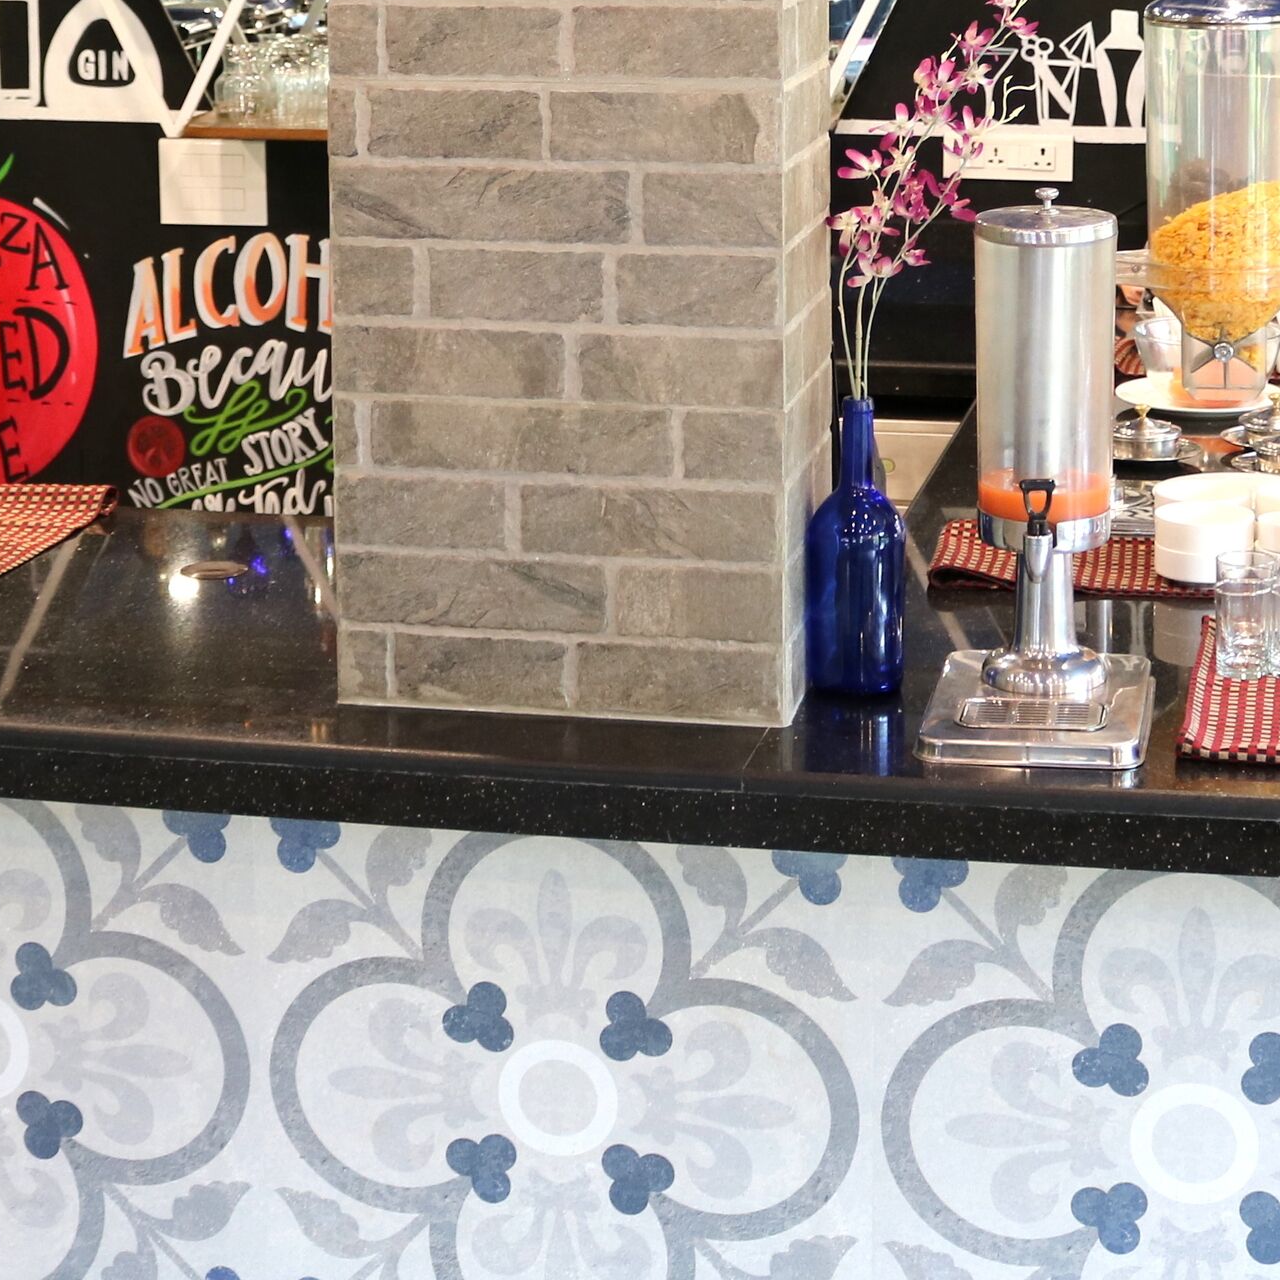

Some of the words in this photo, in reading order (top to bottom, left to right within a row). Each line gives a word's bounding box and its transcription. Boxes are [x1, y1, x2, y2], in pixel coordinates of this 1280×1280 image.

[76, 48, 130, 81] GIN
[127, 478, 166, 510] NO
[166, 457, 228, 497] GREAT
[241, 407, 329, 477] STORY
